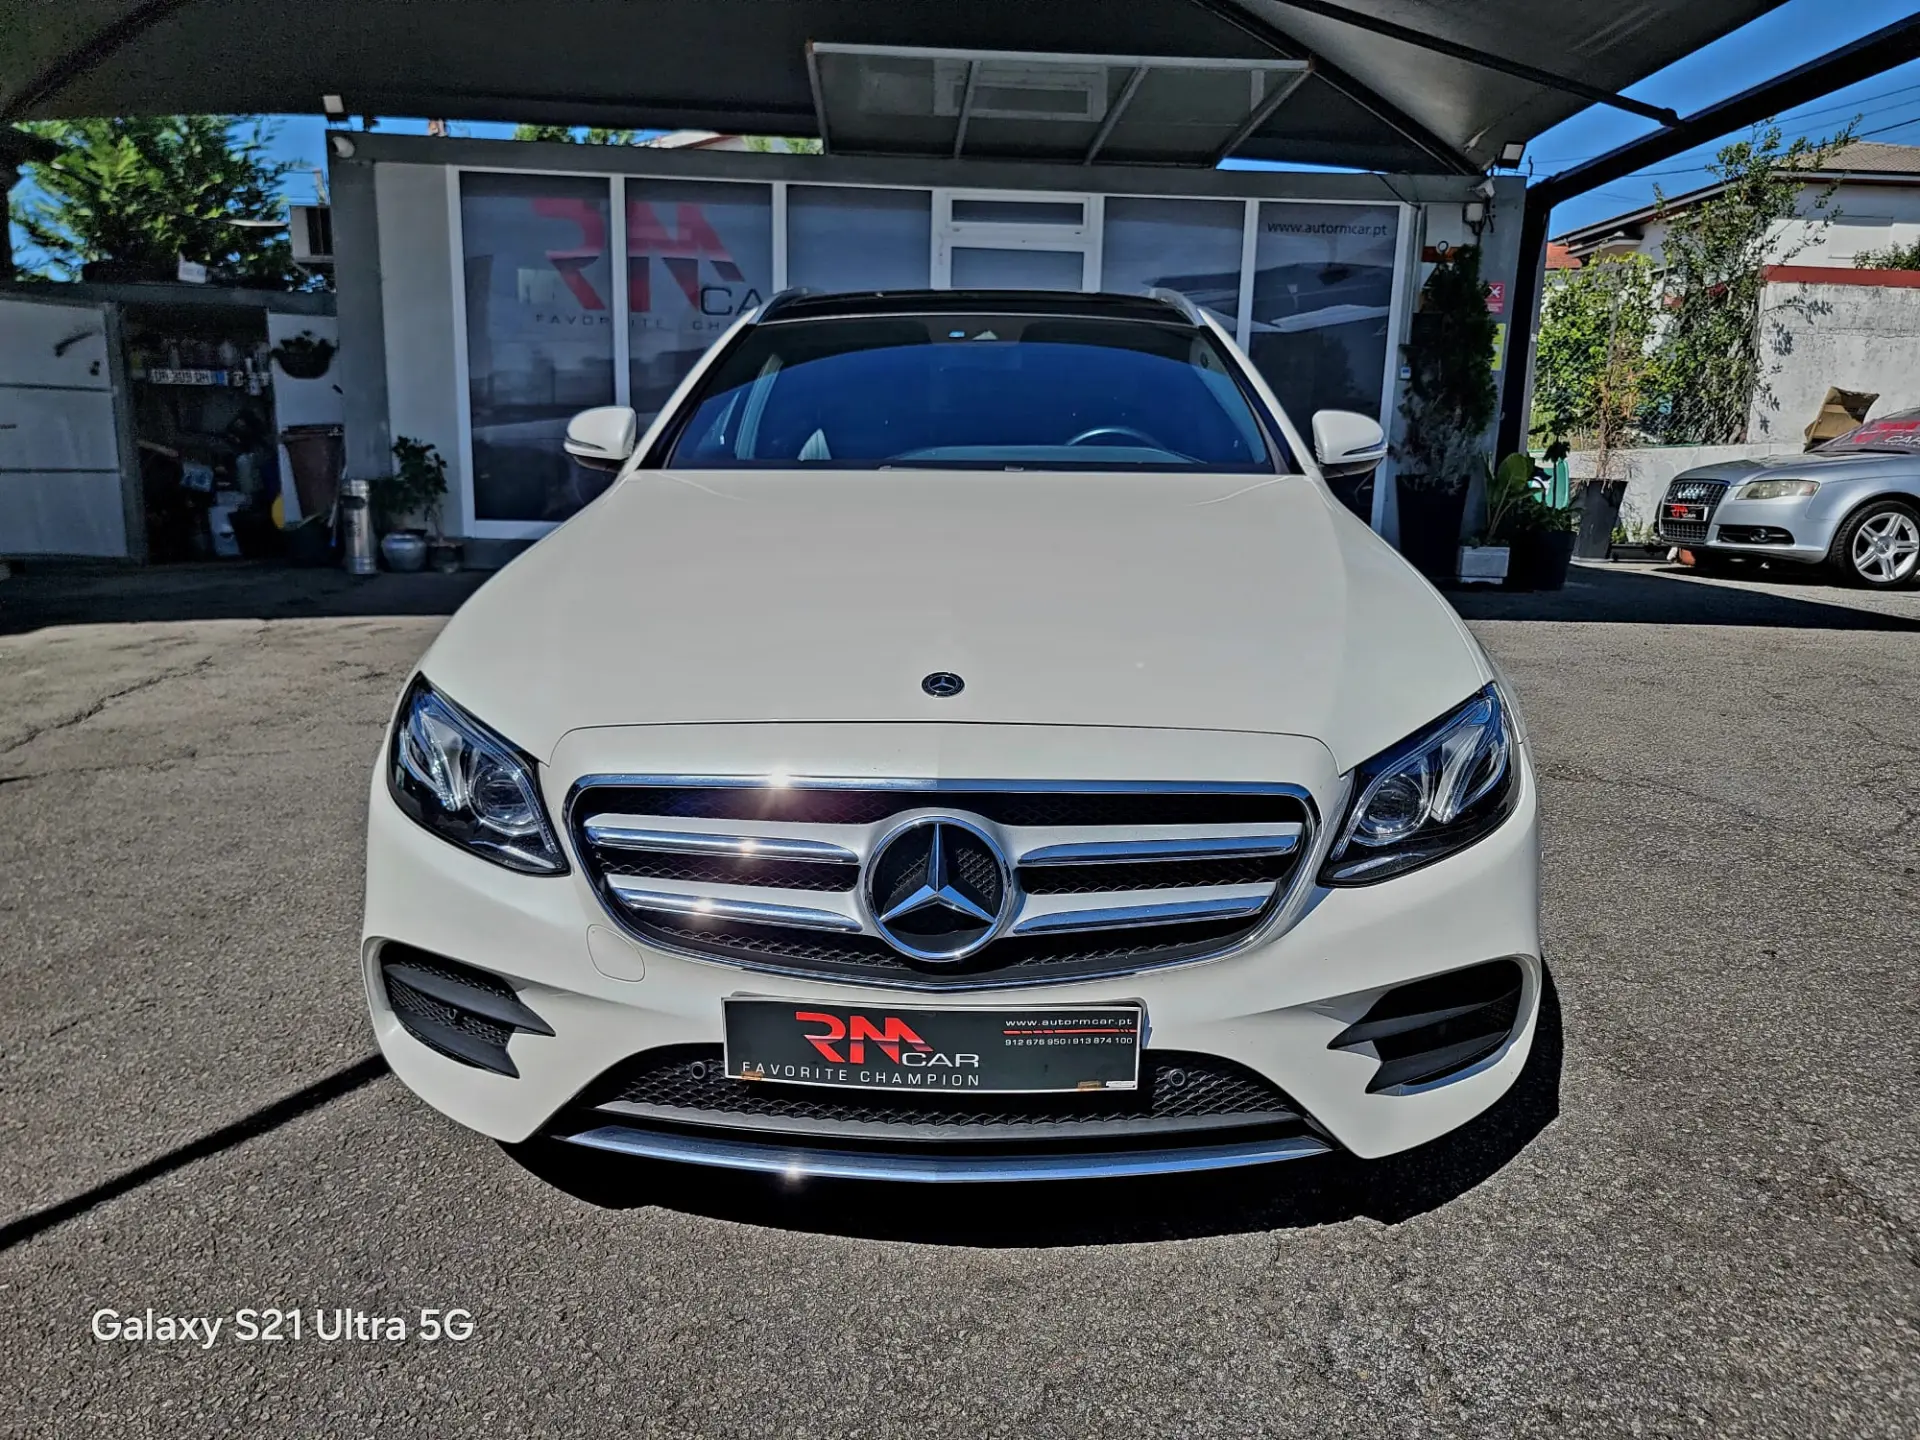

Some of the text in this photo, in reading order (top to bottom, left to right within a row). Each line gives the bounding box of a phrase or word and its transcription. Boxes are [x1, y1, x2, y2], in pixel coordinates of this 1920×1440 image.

[1267, 221, 1388, 237] www.autormcar.pt
[701, 286, 764, 316] CA
[1005, 1018, 1133, 1027] www.autormcar.pt
[795, 1011, 934, 1064] RM
[901, 1052, 979, 1068] CAR
[742, 1061, 980, 1086] FAVORITE CHAMPION
